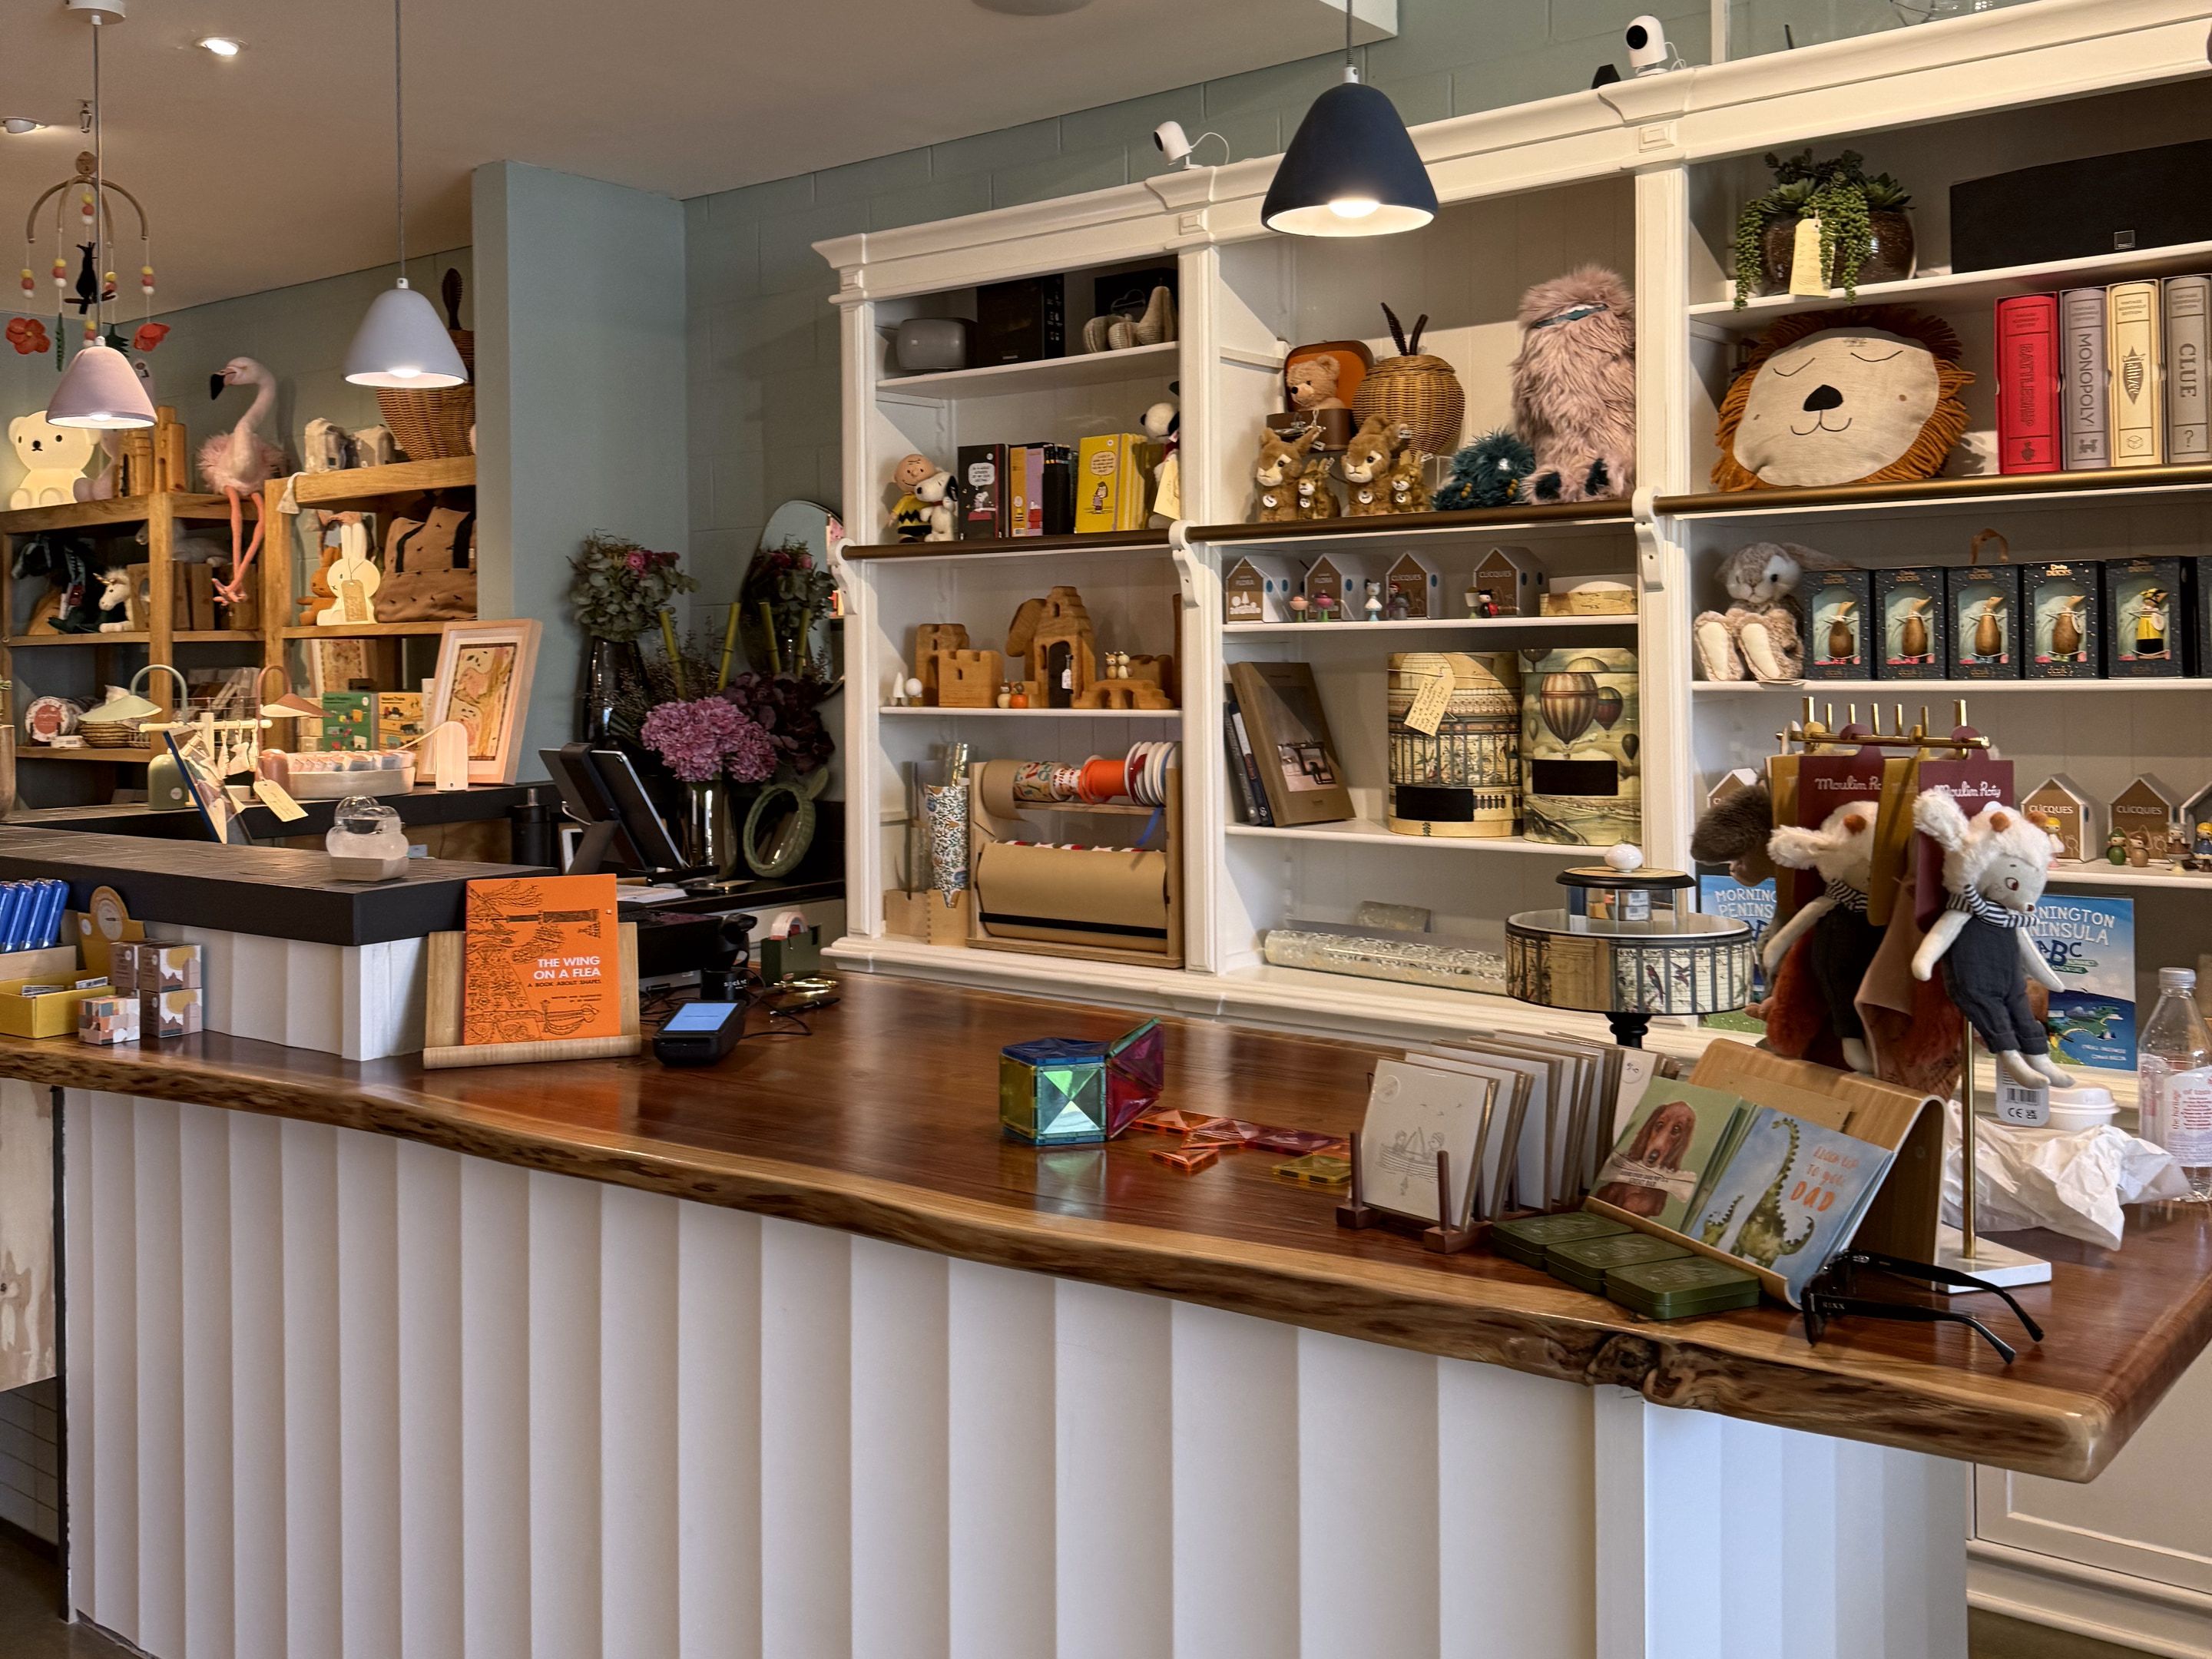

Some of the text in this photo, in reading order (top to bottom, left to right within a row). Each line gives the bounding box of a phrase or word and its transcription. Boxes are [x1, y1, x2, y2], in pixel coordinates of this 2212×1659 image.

[2078, 333, 2095, 425] MONOPOLY
[2179, 343, 2197, 398] CLUE
[2018, 343, 2035, 427] BATTLESHIP
[1814, 775, 1869, 790] Moulin
[1714, 888, 1777, 903] MORNING
[1718, 902, 1774, 919] PENINS
[2038, 906, 2115, 929] NINGTON
[2028, 921, 2109, 947] NINSULA
[538, 955, 601, 968] THE WING
[534, 967, 601, 980] ON A FLEA
[1790, 1181, 1836, 1212] DAD
